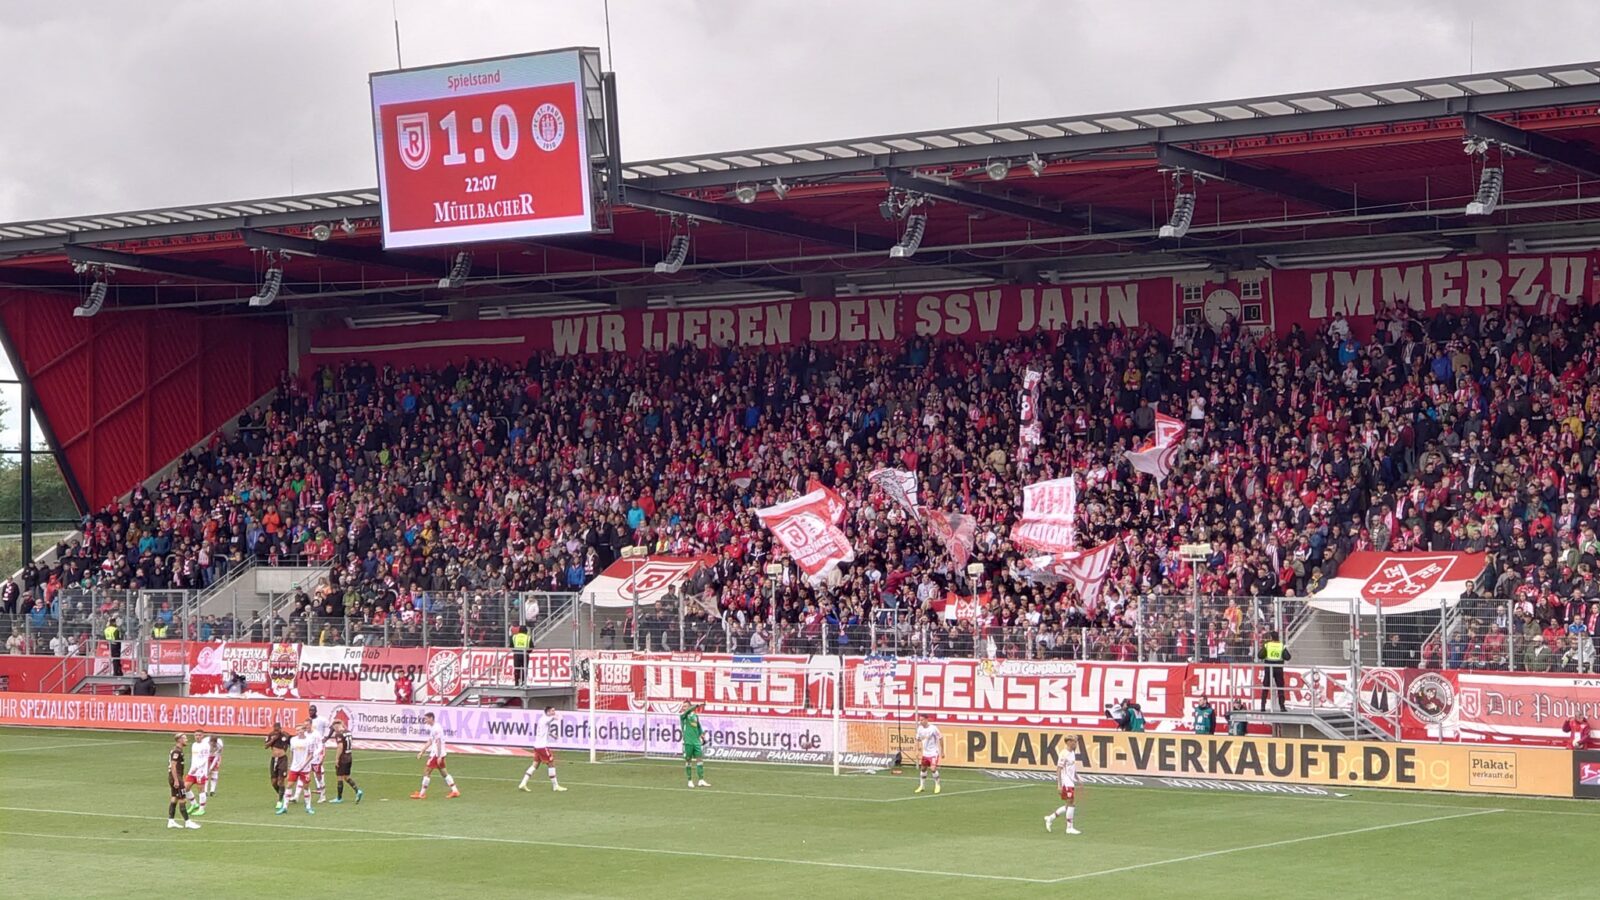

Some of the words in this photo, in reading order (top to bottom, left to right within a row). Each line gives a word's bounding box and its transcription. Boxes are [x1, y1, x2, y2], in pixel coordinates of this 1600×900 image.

[447, 69, 500, 91] Spielstand
[439, 104, 519, 166] 1:0
[465, 175, 497, 193] 22:07
[433, 193, 535, 223] MÜHLBACHER
[1309, 257, 1587, 318] IMMERZU
[552, 314, 625, 356] WIR
[642, 303, 791, 351] LIEBEN
[809, 299, 897, 341] DEN
[915, 290, 1002, 335] SSV
[1017, 284, 1140, 331] JAHN
[344, 648, 380, 659] Fanclub
[300, 662, 403, 683] REGENSBURG
[600, 664, 631, 683] 1889
[1192, 669, 1251, 696] JAHN
[646, 661, 796, 702] ULTRAS
[854, 662, 1169, 714] REGENSBURG
[0, 699, 17, 718] IHR
[20, 699, 81, 720] SPEZIALIST
[84, 697, 104, 720] FÜR
[107, 702, 155, 723] MULDEN
[160, 703, 168, 724] &
[172, 704, 234, 726] ABROLLER
[237, 706, 272, 727] ALLER
[275, 707, 298, 728] ART
[1486, 690, 1524, 716] Die
[358, 712, 388, 723] Thomas
[357, 725, 407, 735] Malerfachbetrieb
[715, 748, 761, 759] Dallmeier
[843, 754, 892, 765] Dallmeier
[968, 730, 1415, 783] PLAKAT-VERKAUFT.DE
[1472, 758, 1514, 770] Plakat-
[1472, 771, 1514, 779] verkauft.de
